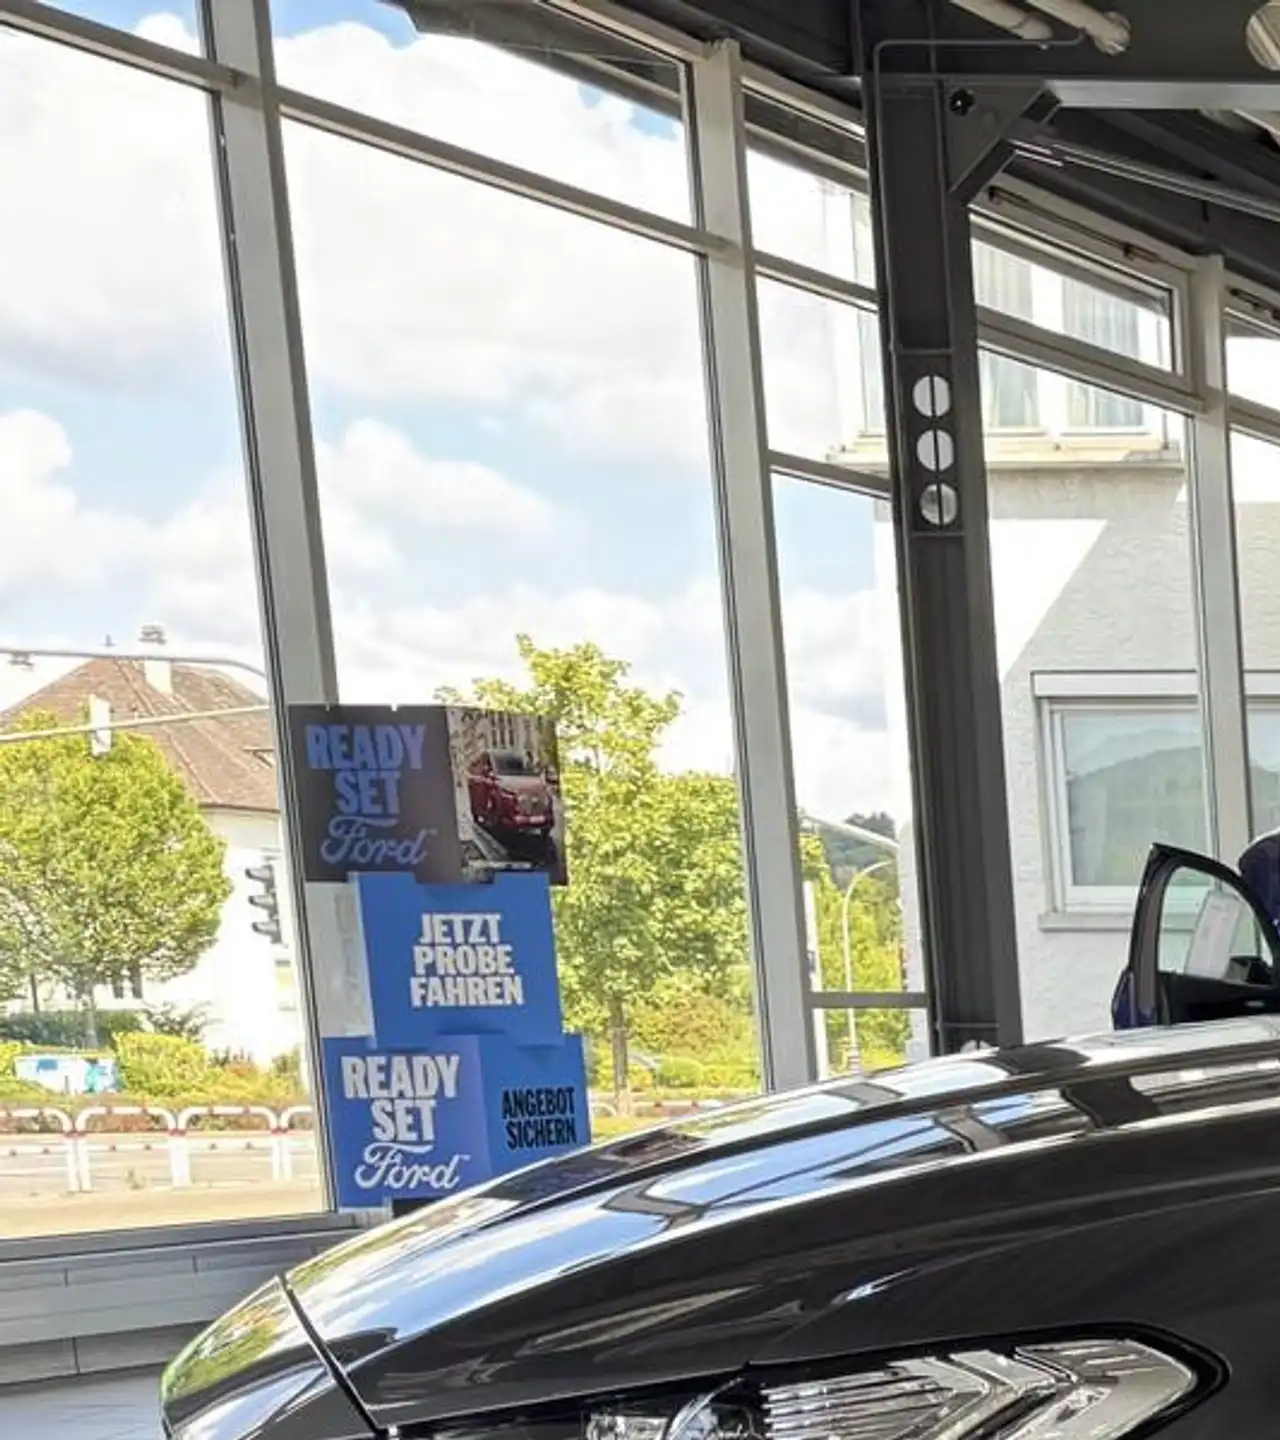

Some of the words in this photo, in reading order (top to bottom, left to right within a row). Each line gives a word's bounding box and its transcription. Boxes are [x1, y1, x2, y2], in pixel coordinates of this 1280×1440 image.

[306, 724, 427, 770] READY
[334, 769, 401, 815] SET
[321, 816, 429, 865] Ford
[419, 913, 501, 945] JETZT
[413, 945, 514, 976] PROBE
[410, 976, 524, 1007] FAHREN
[341, 1055, 460, 1100] READY
[370, 1098, 437, 1142] SET
[501, 1087, 575, 1119] ANGEBOT
[506, 1117, 578, 1151] SICHERN
[354, 1142, 461, 1191] Ford
